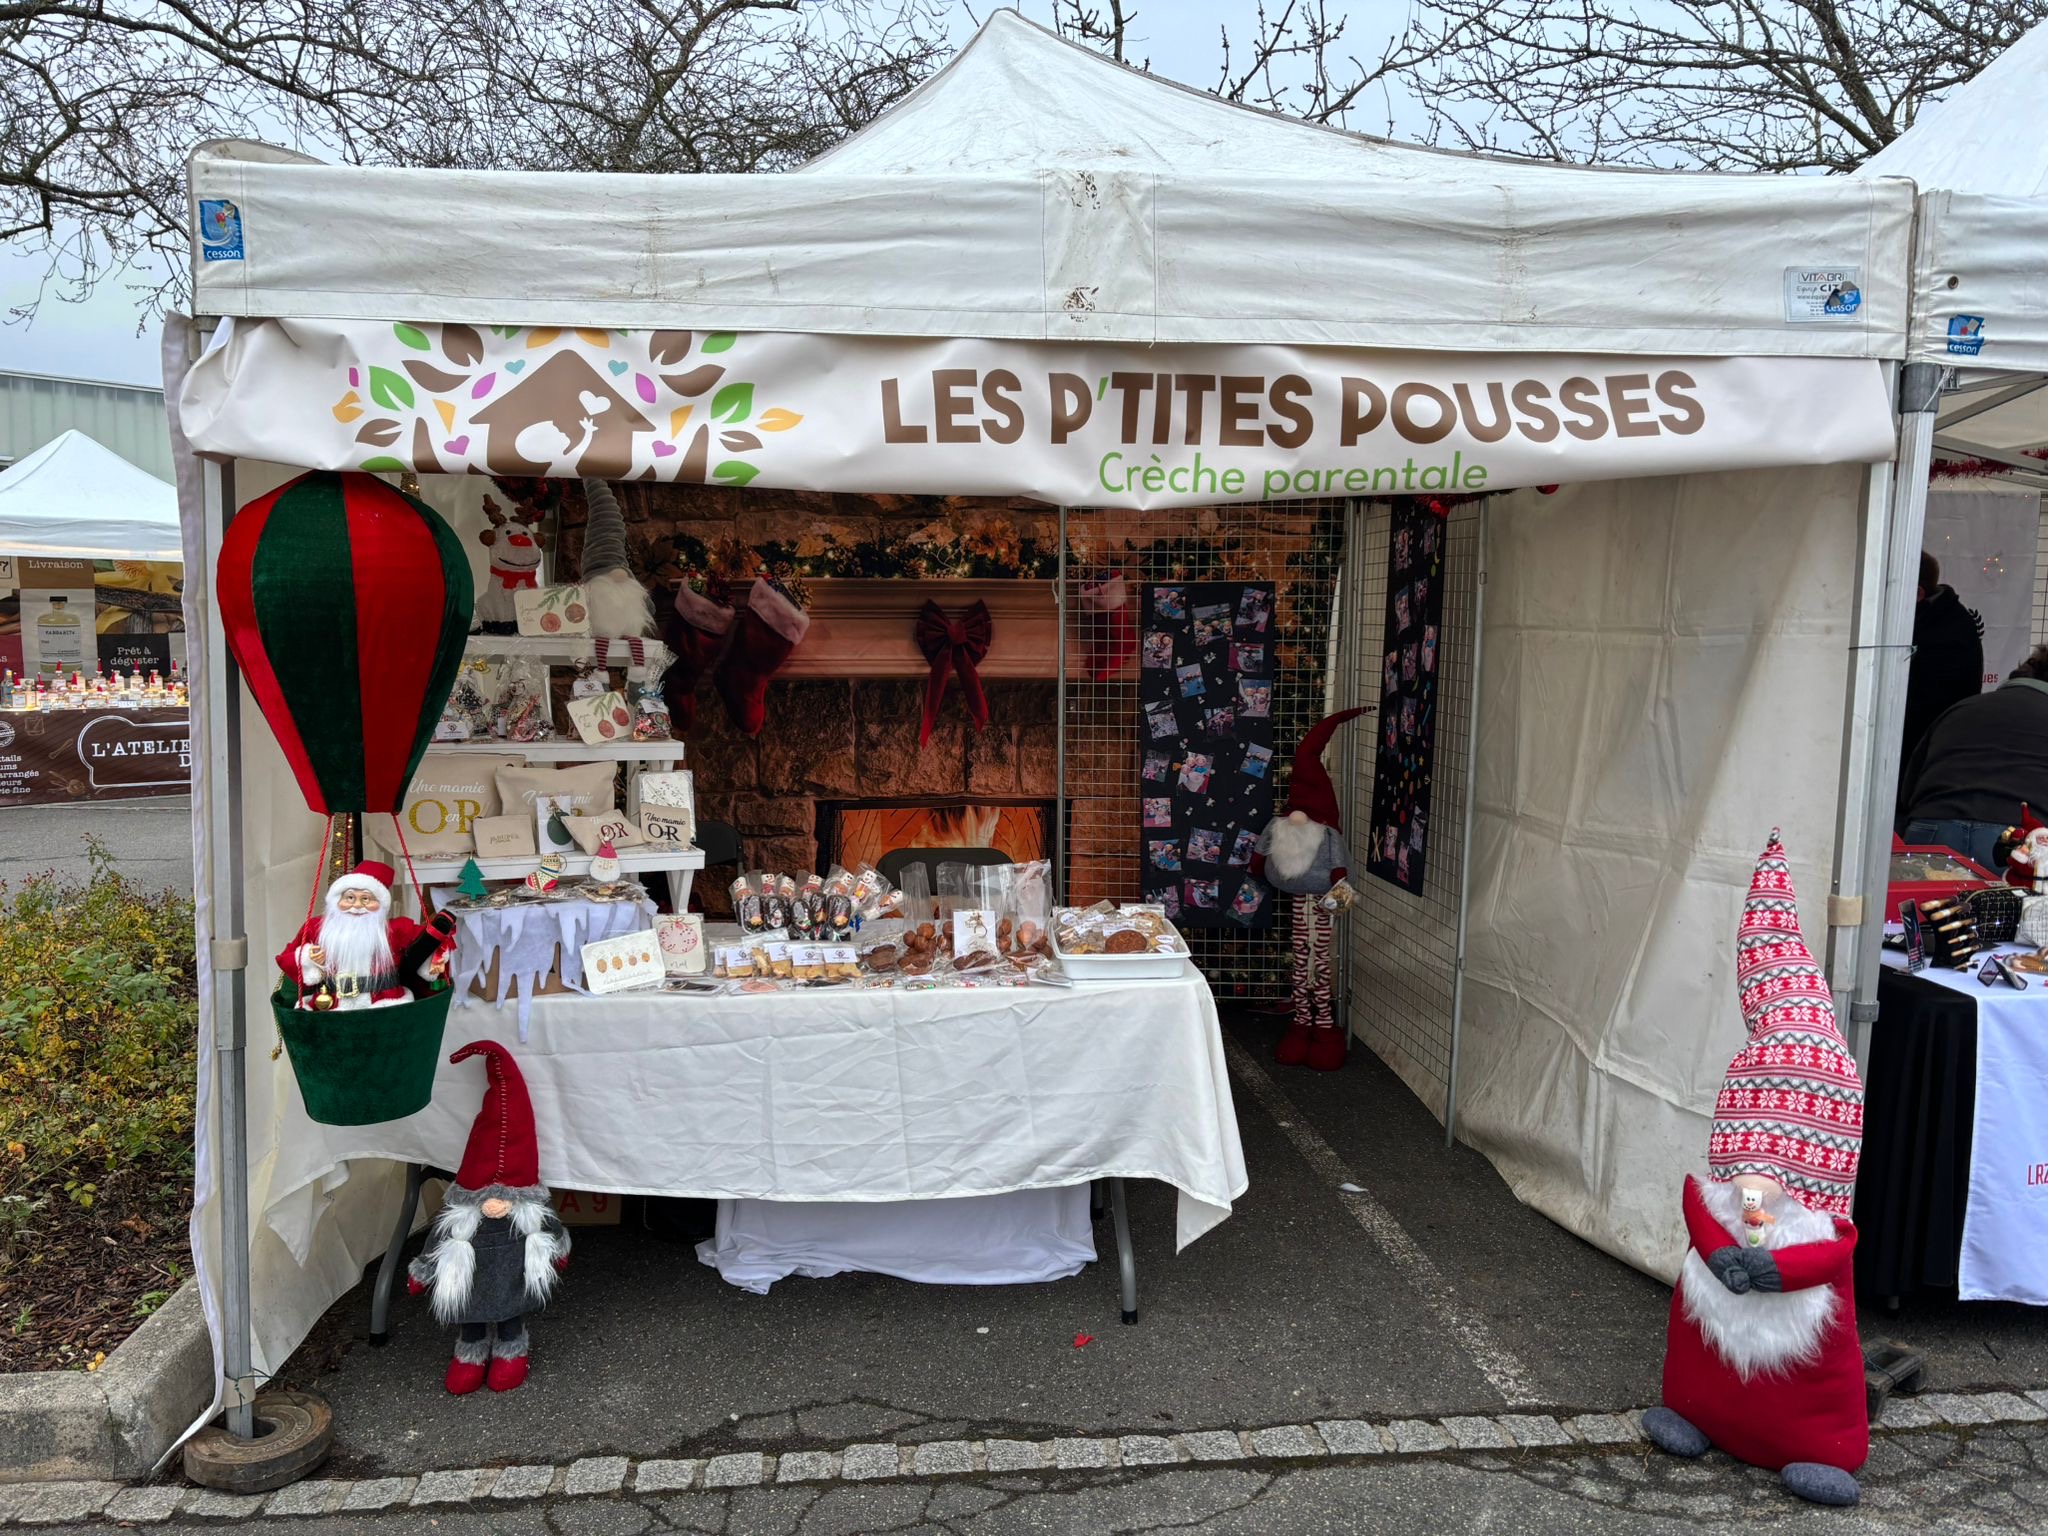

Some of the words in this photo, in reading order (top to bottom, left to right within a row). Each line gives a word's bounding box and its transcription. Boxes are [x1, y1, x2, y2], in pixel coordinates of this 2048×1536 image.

[206, 250, 241, 259] cesson
[1949, 344, 1977, 355] cesson
[880, 368, 1025, 446] LES
[1048, 371, 1314, 449] P'TITES
[1340, 369, 1706, 447] POUSSES
[1099, 451, 1245, 494] Crèche
[1262, 450, 1489, 501] parentale
[28, 560, 84, 569] Livraison
[117, 646, 141, 655] Prêt
[144, 646, 151, 655] à
[12, 786, 31, 794] fine
[408, 779, 436, 793] Une
[440, 781, 486, 793] mamie
[408, 798, 481, 835] OR
[644, 812, 661, 823] Une
[661, 817, 686, 826] mamie
[647, 823, 682, 842] OR
